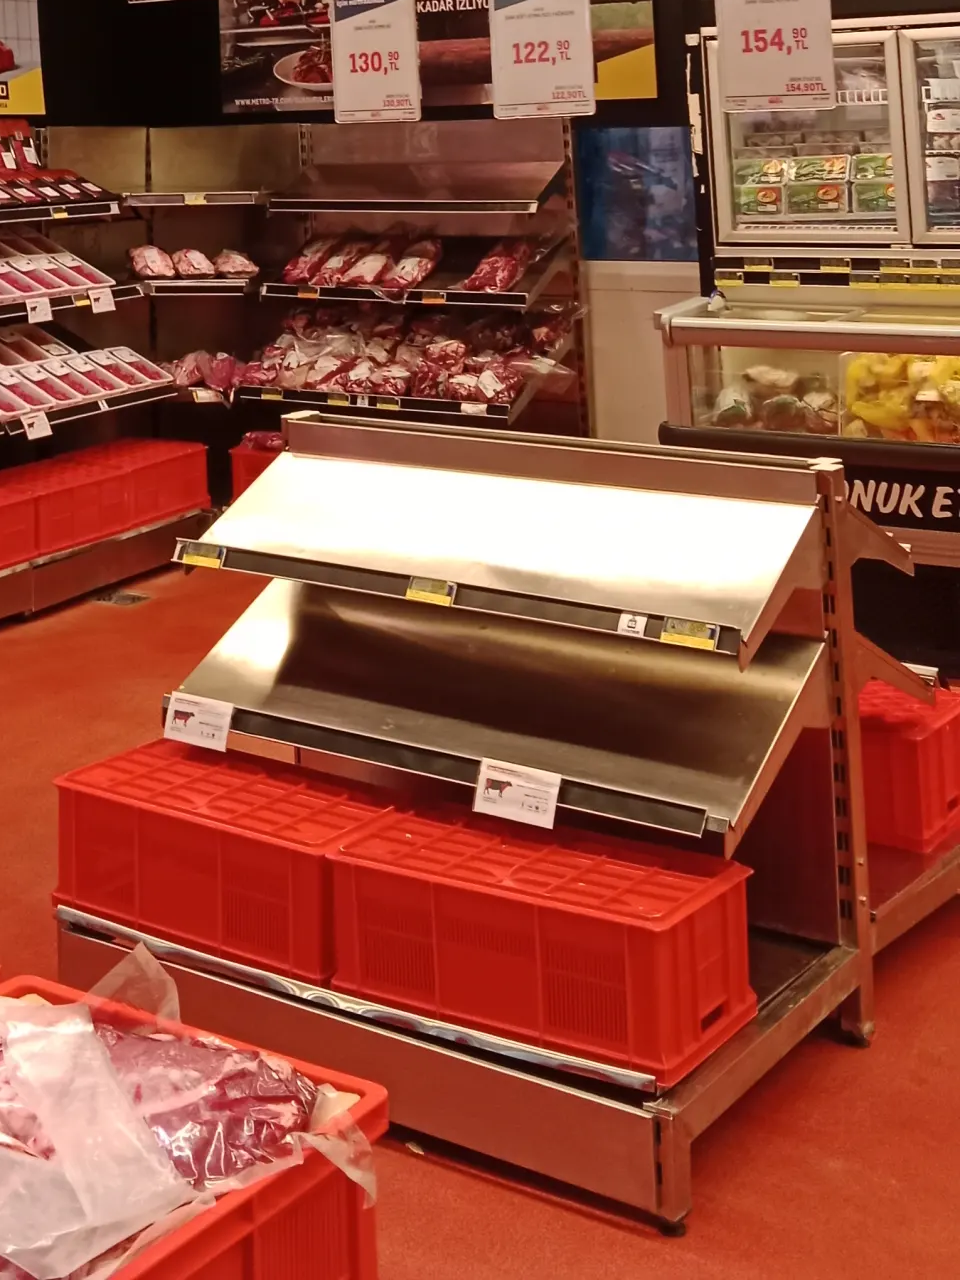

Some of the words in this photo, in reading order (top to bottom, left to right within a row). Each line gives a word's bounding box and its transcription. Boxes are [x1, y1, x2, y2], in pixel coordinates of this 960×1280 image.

[794, 40, 809, 50] TL
[559, 51, 571, 60] TL
[389, 62, 399, 71] TL
[932, 486, 960, 518] E
